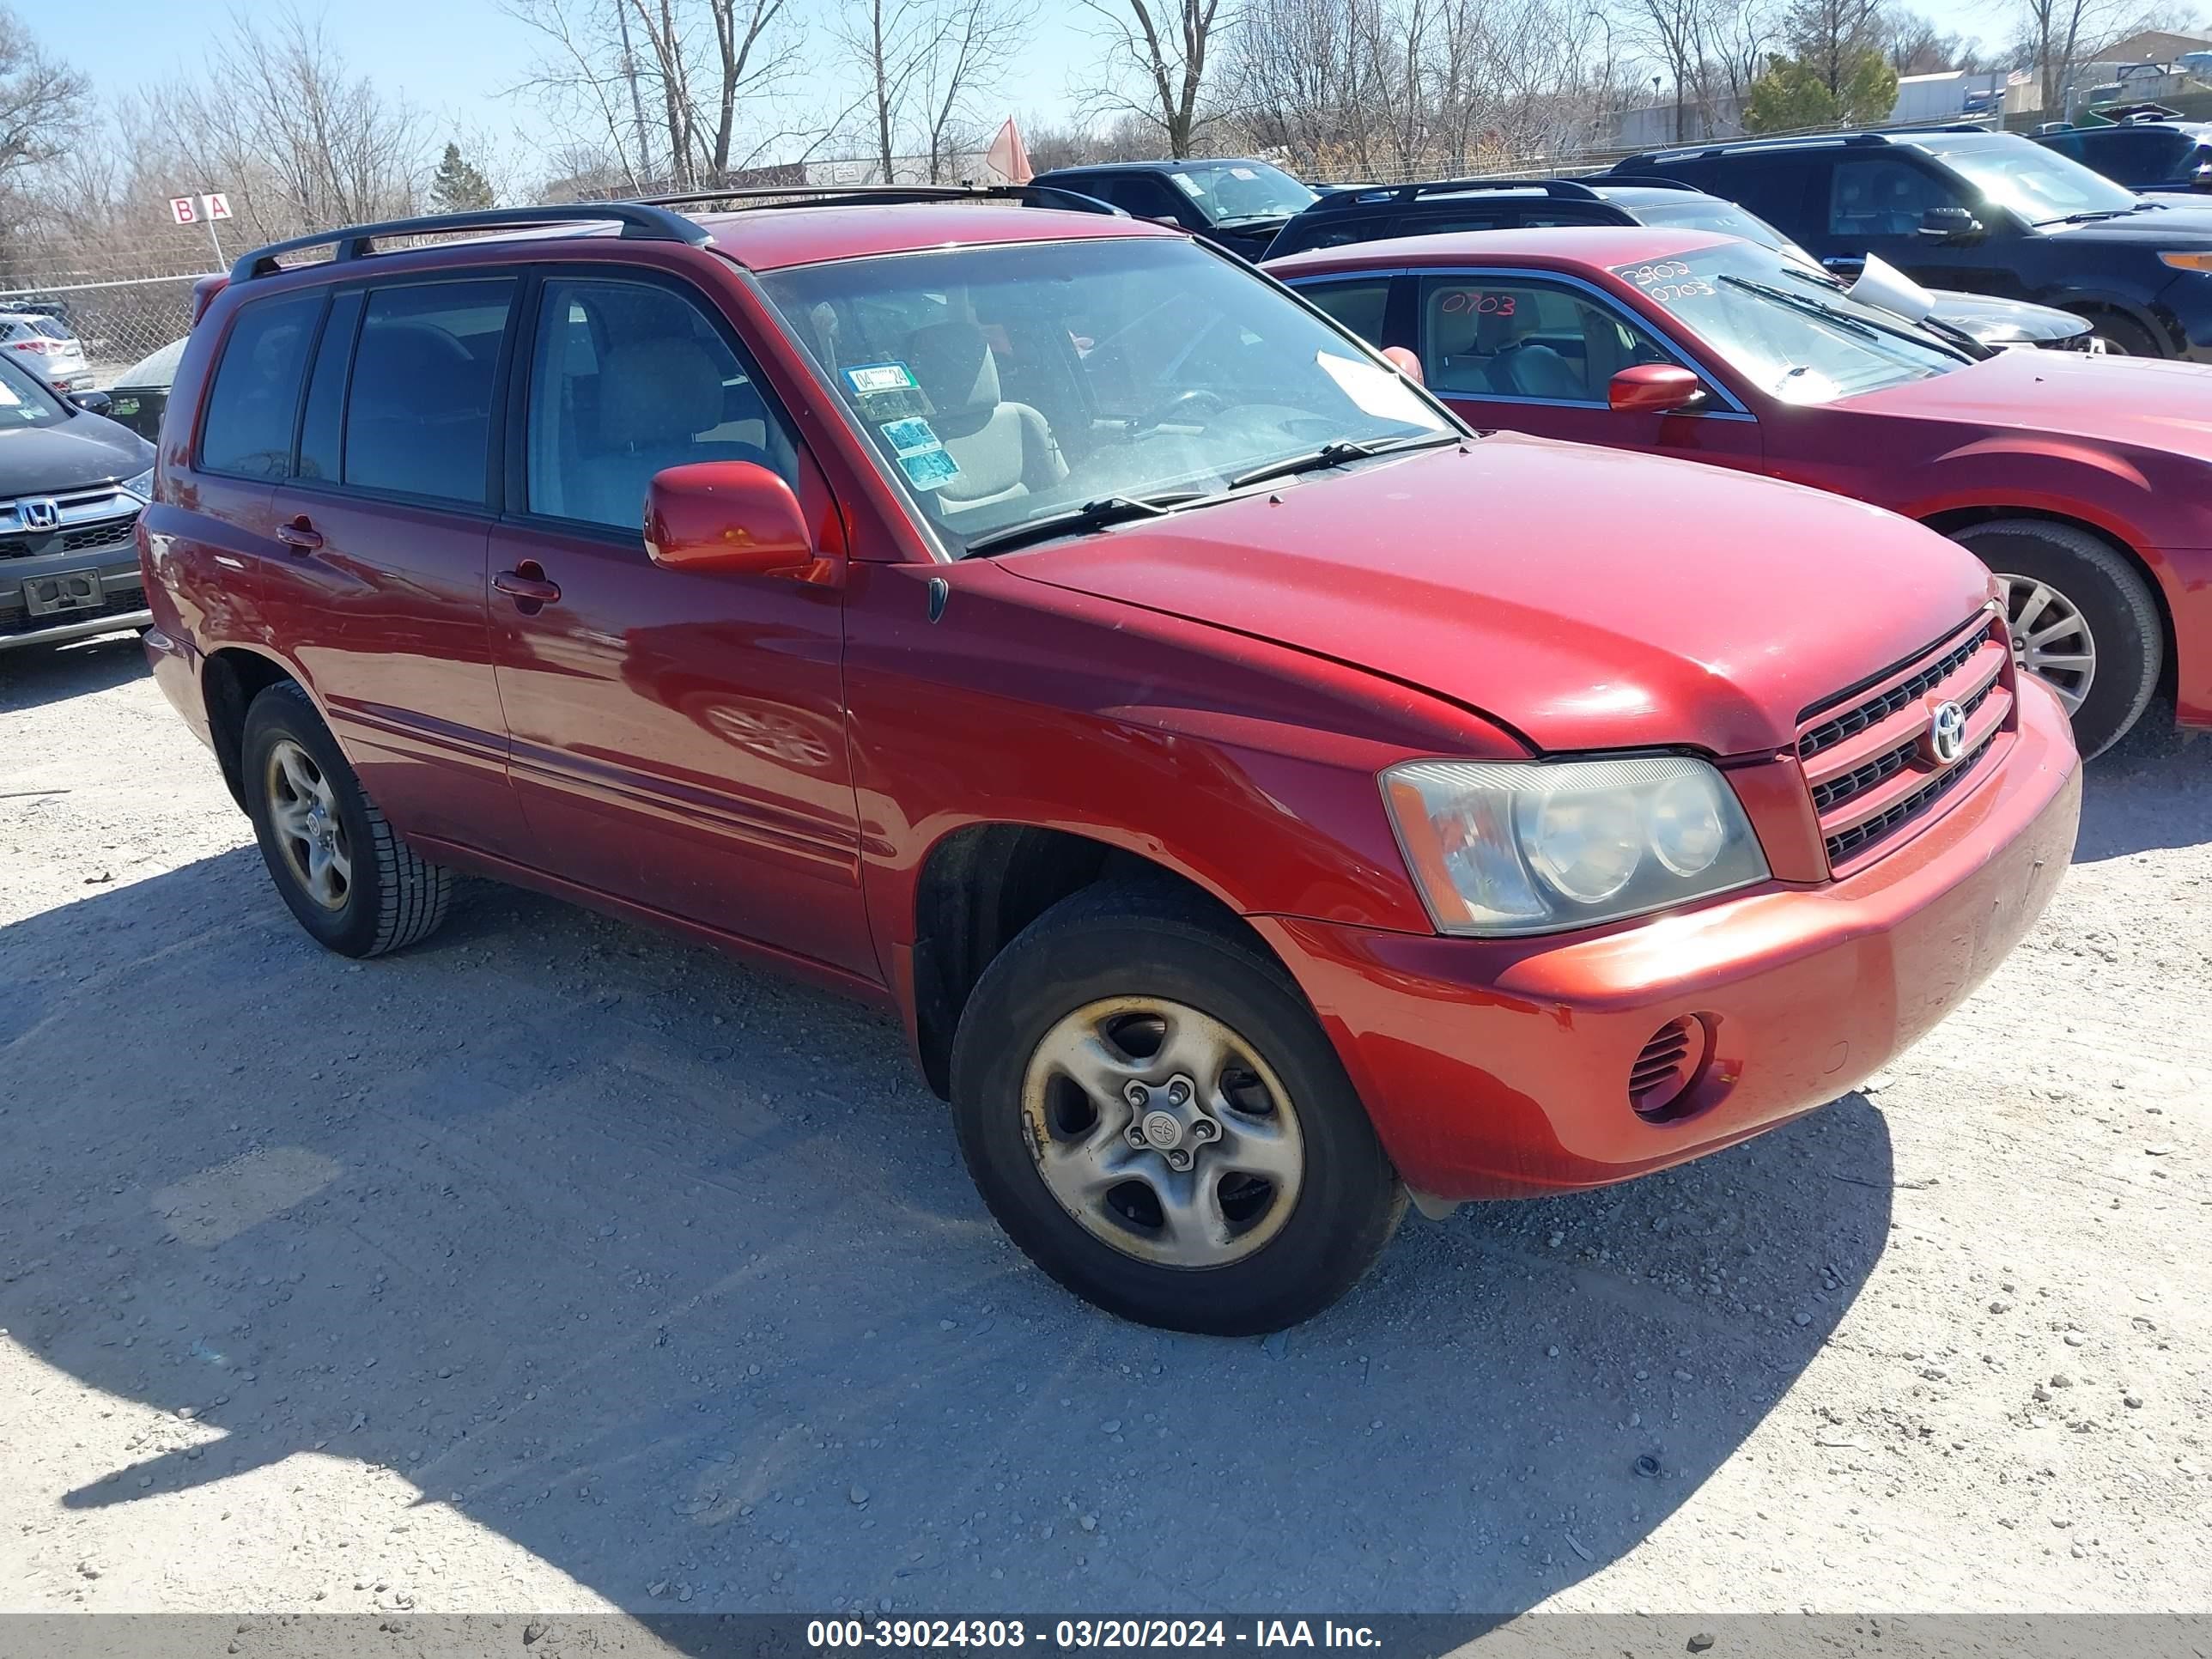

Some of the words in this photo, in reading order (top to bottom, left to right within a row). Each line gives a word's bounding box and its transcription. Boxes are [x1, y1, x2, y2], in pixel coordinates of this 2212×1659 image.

[175, 200, 193, 222] B
[212, 196, 228, 218] A
[1650, 281, 1717, 301] 0703
[1442, 293, 1516, 316] 0703
